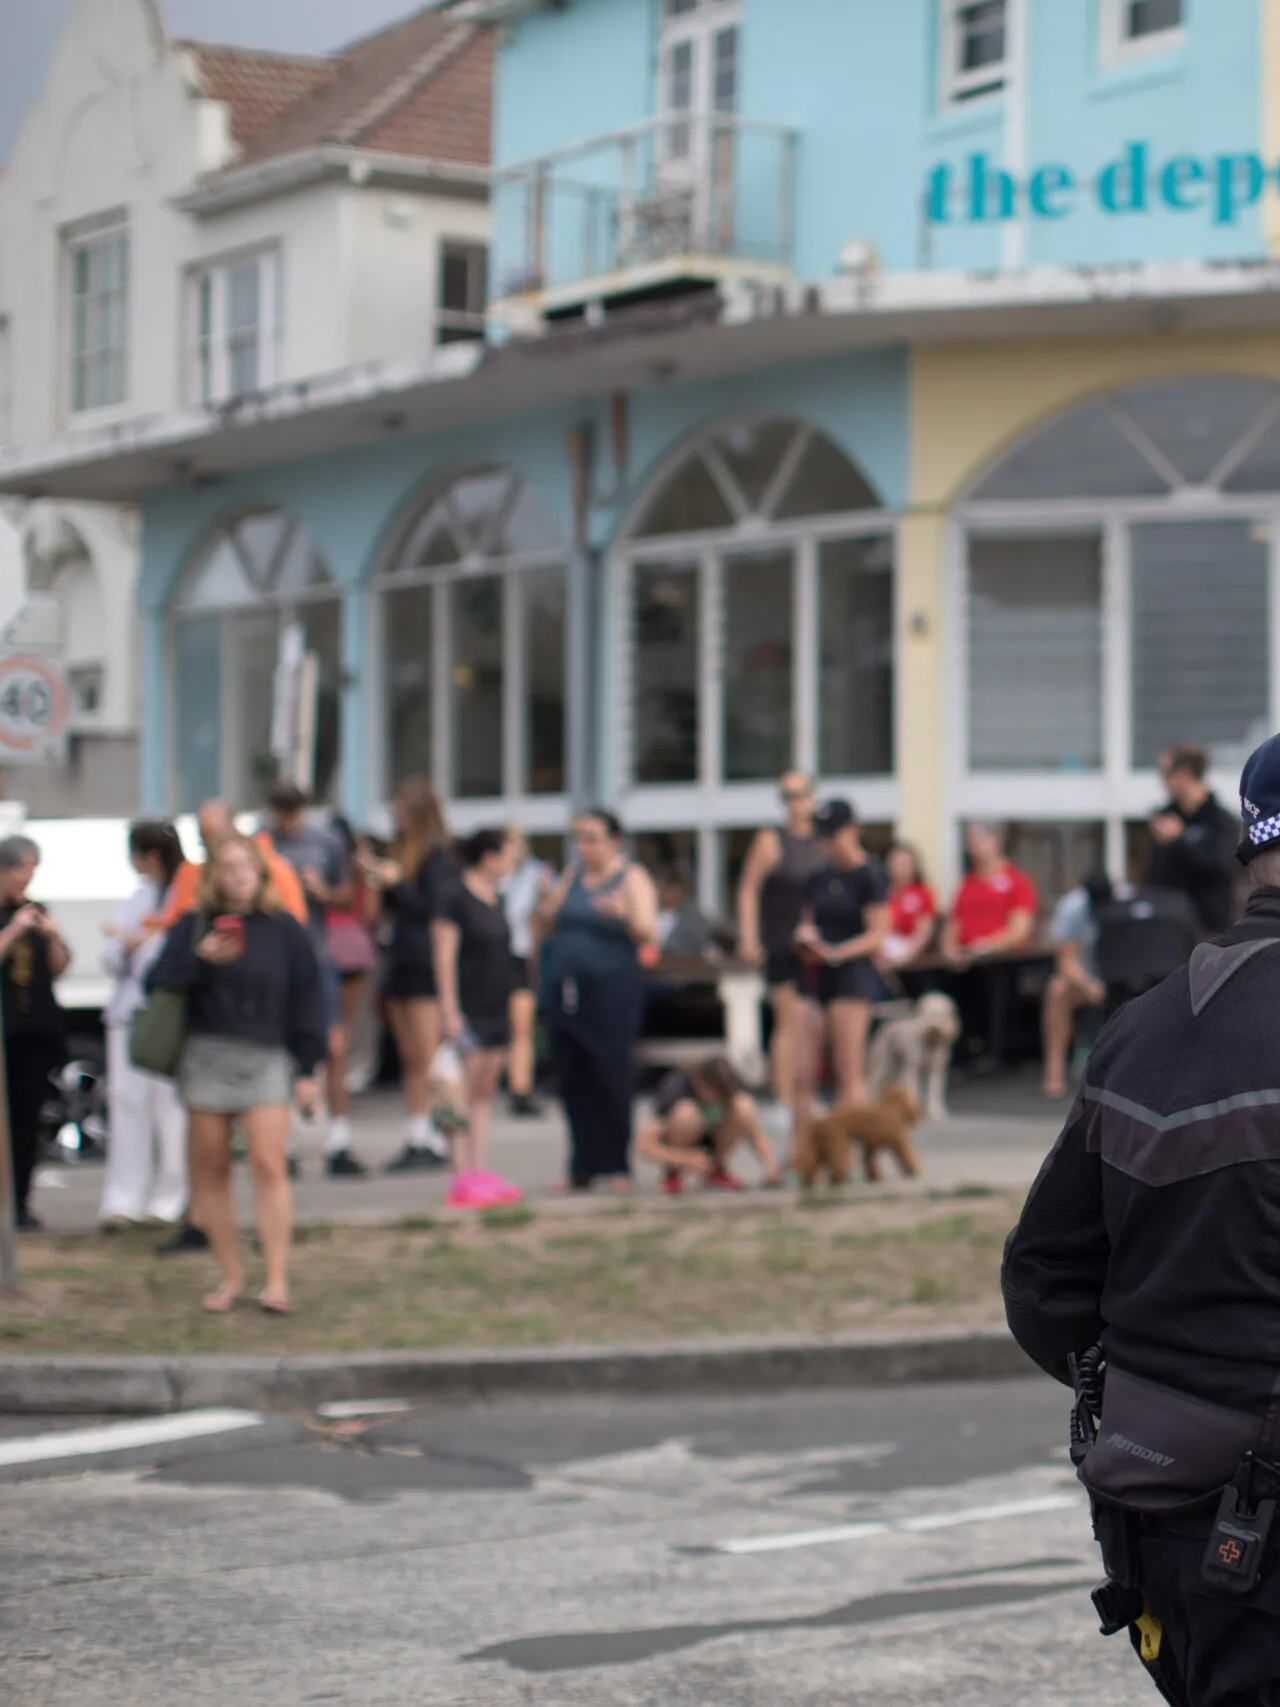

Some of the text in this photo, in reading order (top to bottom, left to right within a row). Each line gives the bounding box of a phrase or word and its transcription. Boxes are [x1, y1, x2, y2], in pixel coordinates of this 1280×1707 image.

[927, 151, 1073, 224] the
[0, 680, 53, 727] 40
[1106, 1432, 1175, 1467] MOTODRY
